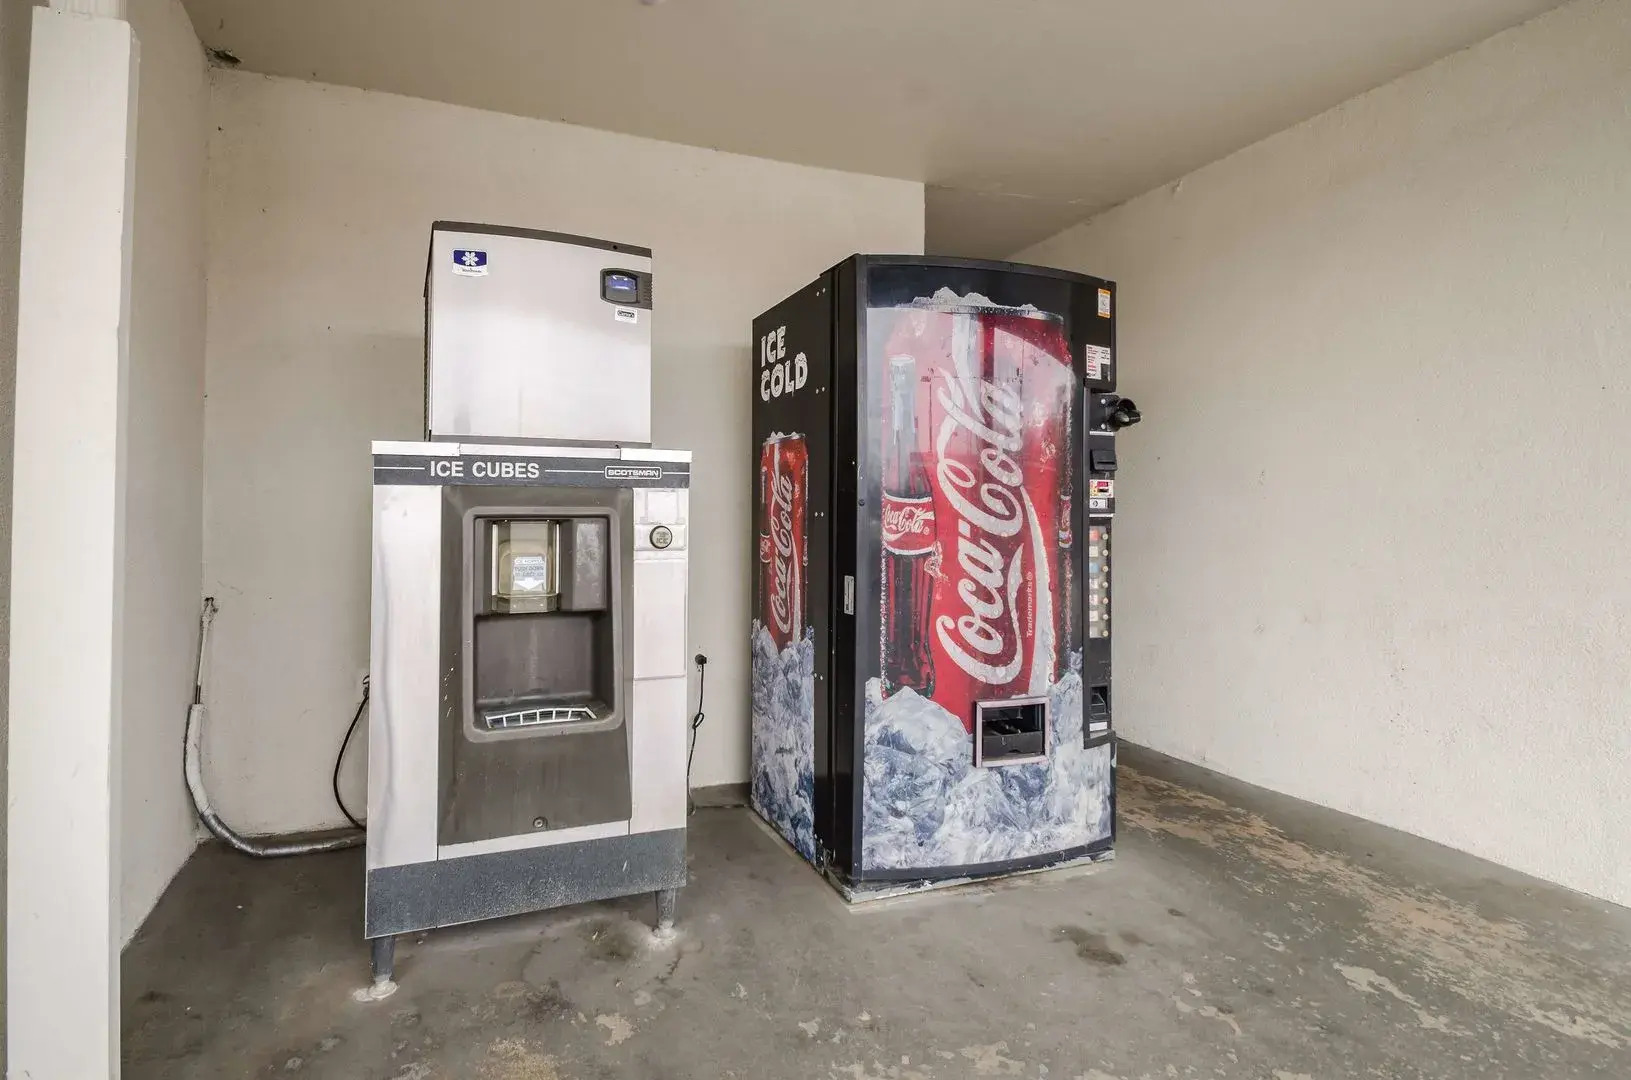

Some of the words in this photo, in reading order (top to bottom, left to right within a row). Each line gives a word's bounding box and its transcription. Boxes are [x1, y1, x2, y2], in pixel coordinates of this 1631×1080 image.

[760, 325, 786, 368] ICE
[760, 351, 809, 402] COLD
[430, 460, 464, 477] ICE
[472, 461, 540, 479] CUBES
[607, 468, 660, 477] SCOTSMAN
